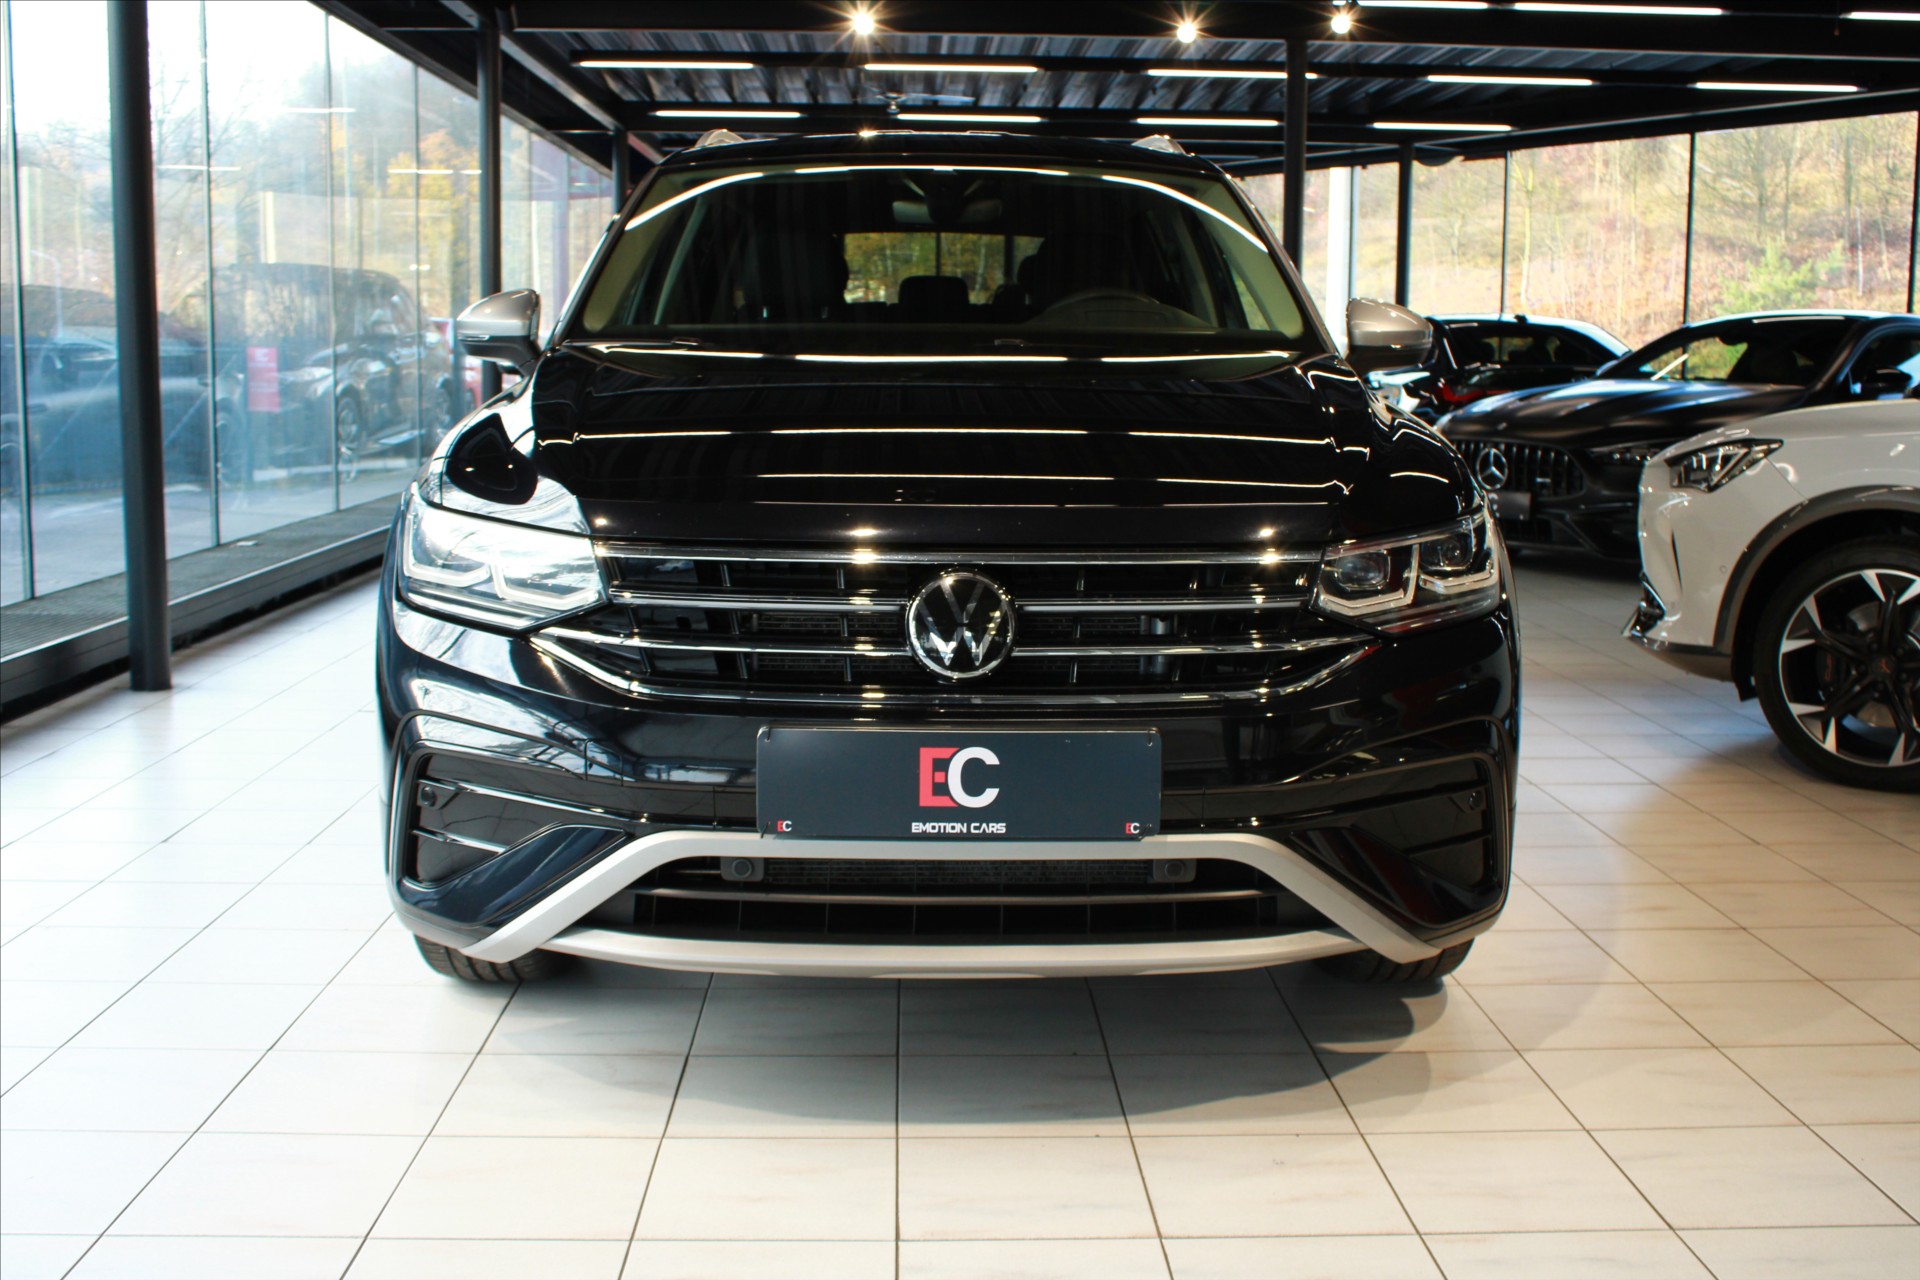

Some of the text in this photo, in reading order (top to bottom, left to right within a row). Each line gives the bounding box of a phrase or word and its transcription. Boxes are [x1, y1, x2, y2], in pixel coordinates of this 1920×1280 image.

[915, 574, 1007, 668] VW
[919, 746, 1000, 808] EC
[777, 820, 792, 832] EC
[911, 822, 1006, 834] EMOTION CARS
[1125, 822, 1140, 834] EC
